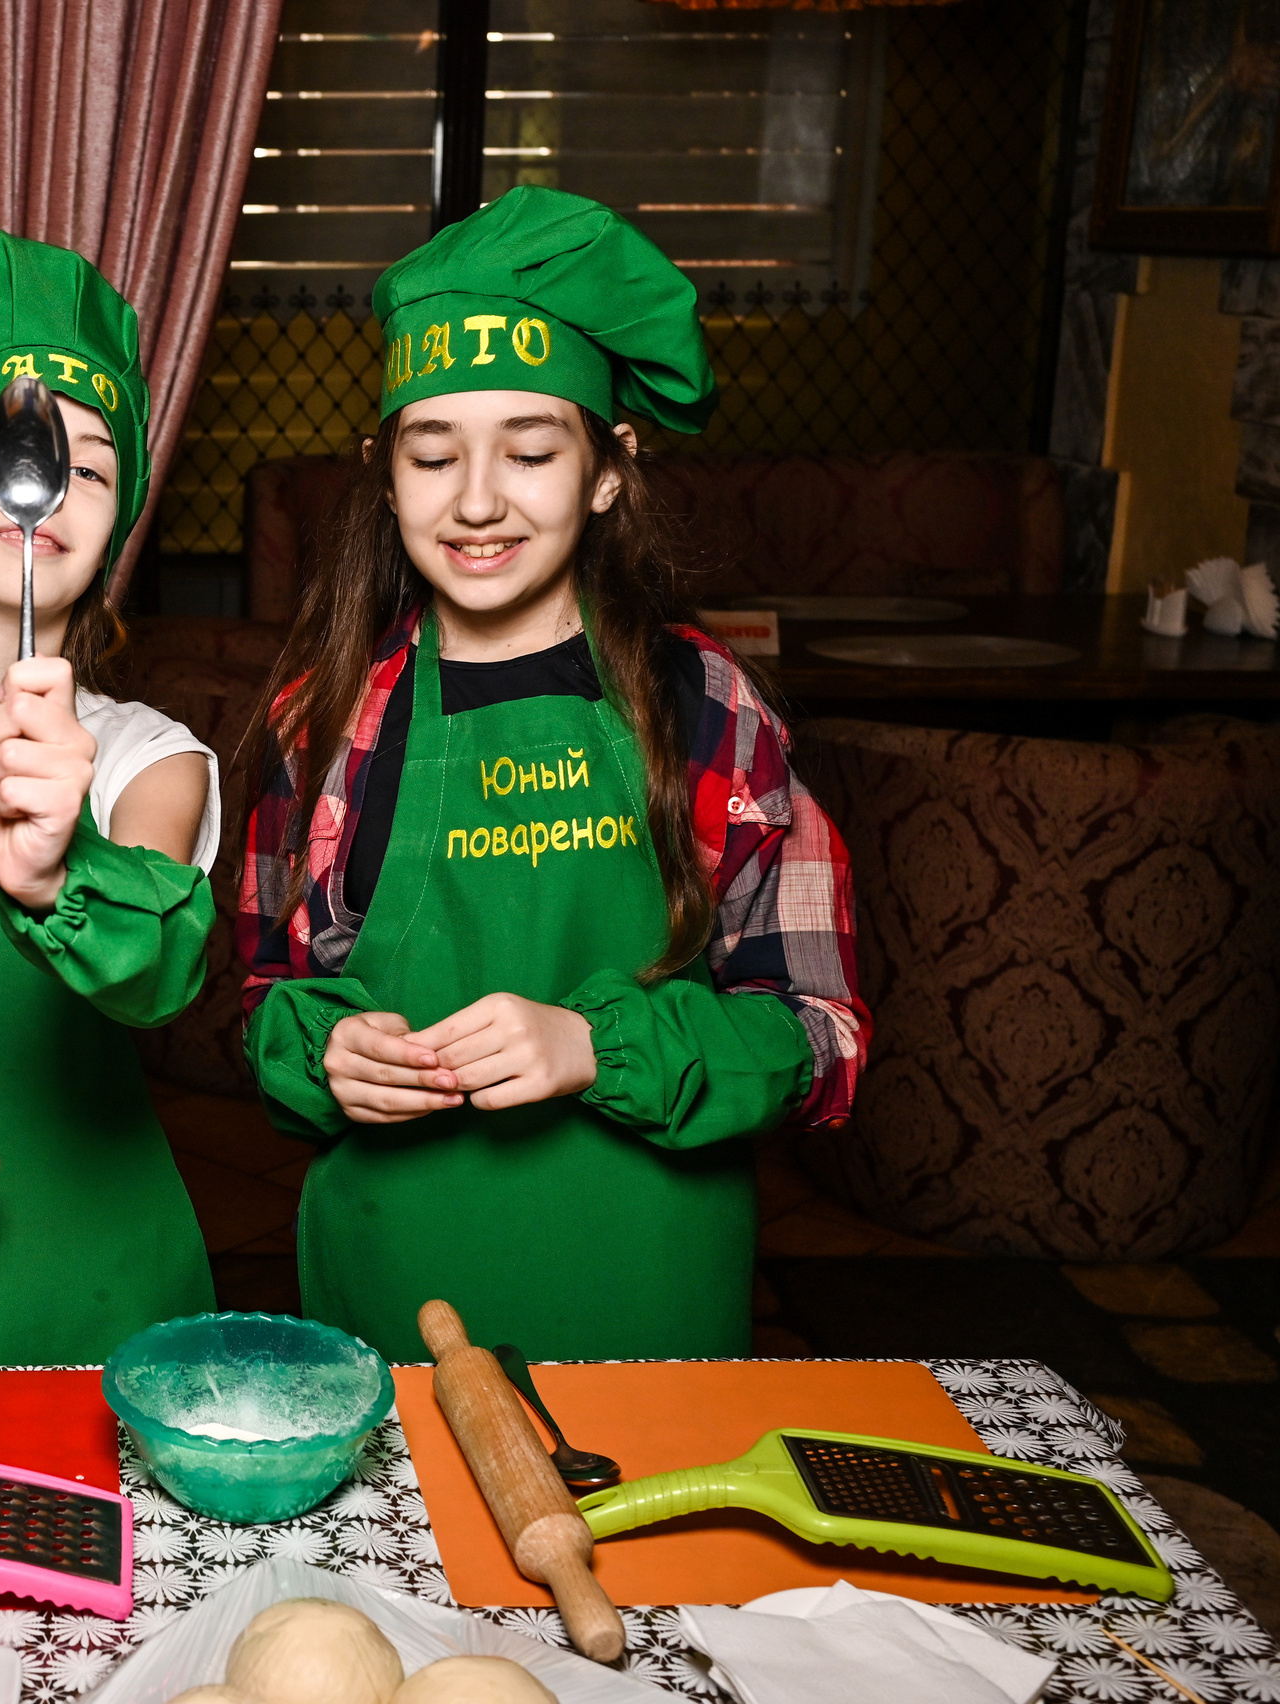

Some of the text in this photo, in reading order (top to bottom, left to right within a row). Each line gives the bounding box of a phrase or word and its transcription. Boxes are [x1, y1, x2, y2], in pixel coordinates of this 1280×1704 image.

[387, 314, 551, 394] ШАТО
[480, 747, 590, 800] Юный
[447, 815, 638, 868] поваренок
